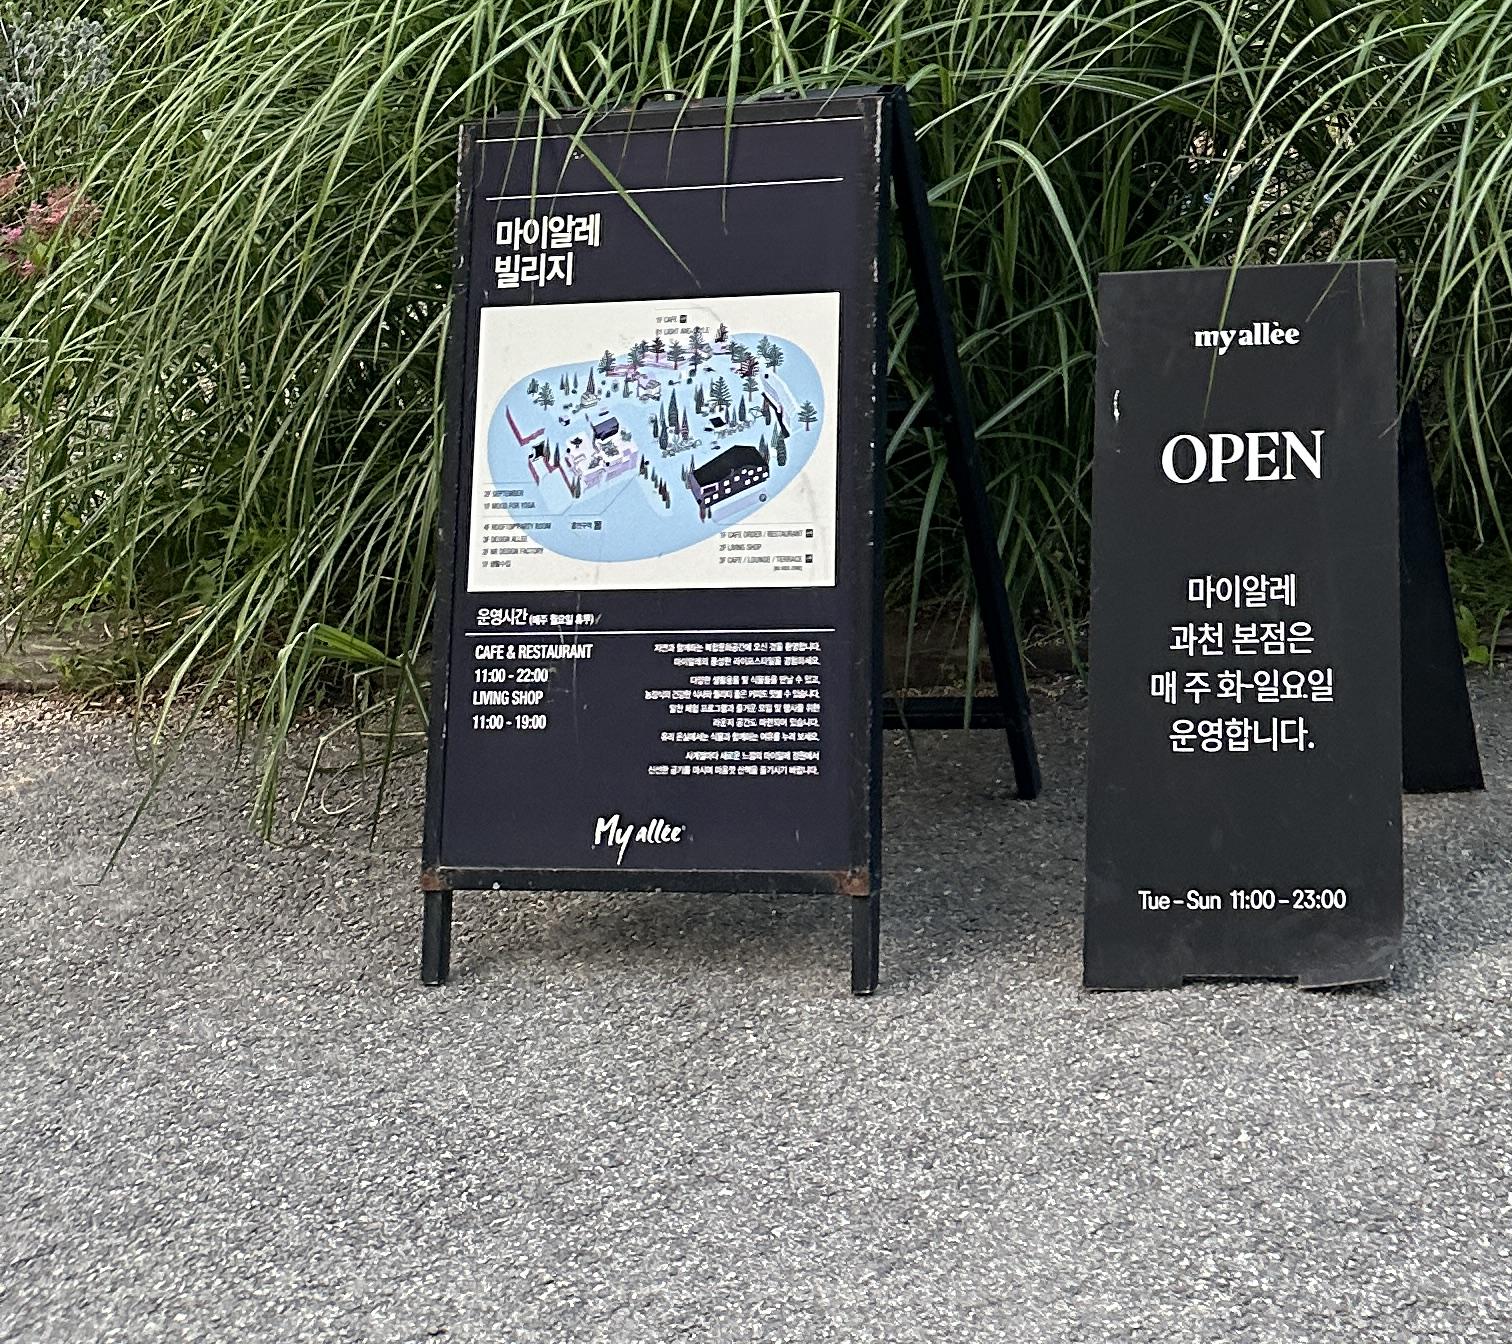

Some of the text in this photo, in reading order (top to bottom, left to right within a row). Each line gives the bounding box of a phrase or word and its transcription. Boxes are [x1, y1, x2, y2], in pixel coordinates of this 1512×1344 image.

[496, 212, 601, 251] 마이알레
[494, 251, 575, 289] 빌리지
[1161, 430, 1326, 484] OPEN
[1188, 573, 1297, 609] 마이알레
[476, 607, 528, 626] 운영시간
[475, 643, 593, 660] CAFE & RESTAURANT
[1169, 621, 1316, 657] 과천 본점은
[474, 668, 506, 683] 11:00
[516, 668, 549, 683] 22:00
[472, 690, 544, 706] LIVING SHOP
[472, 714, 504, 730] 11:00
[514, 714, 547, 730] 19:00
[1169, 716, 1315, 753] 운영합니다.
[594, 814, 634, 866] My
